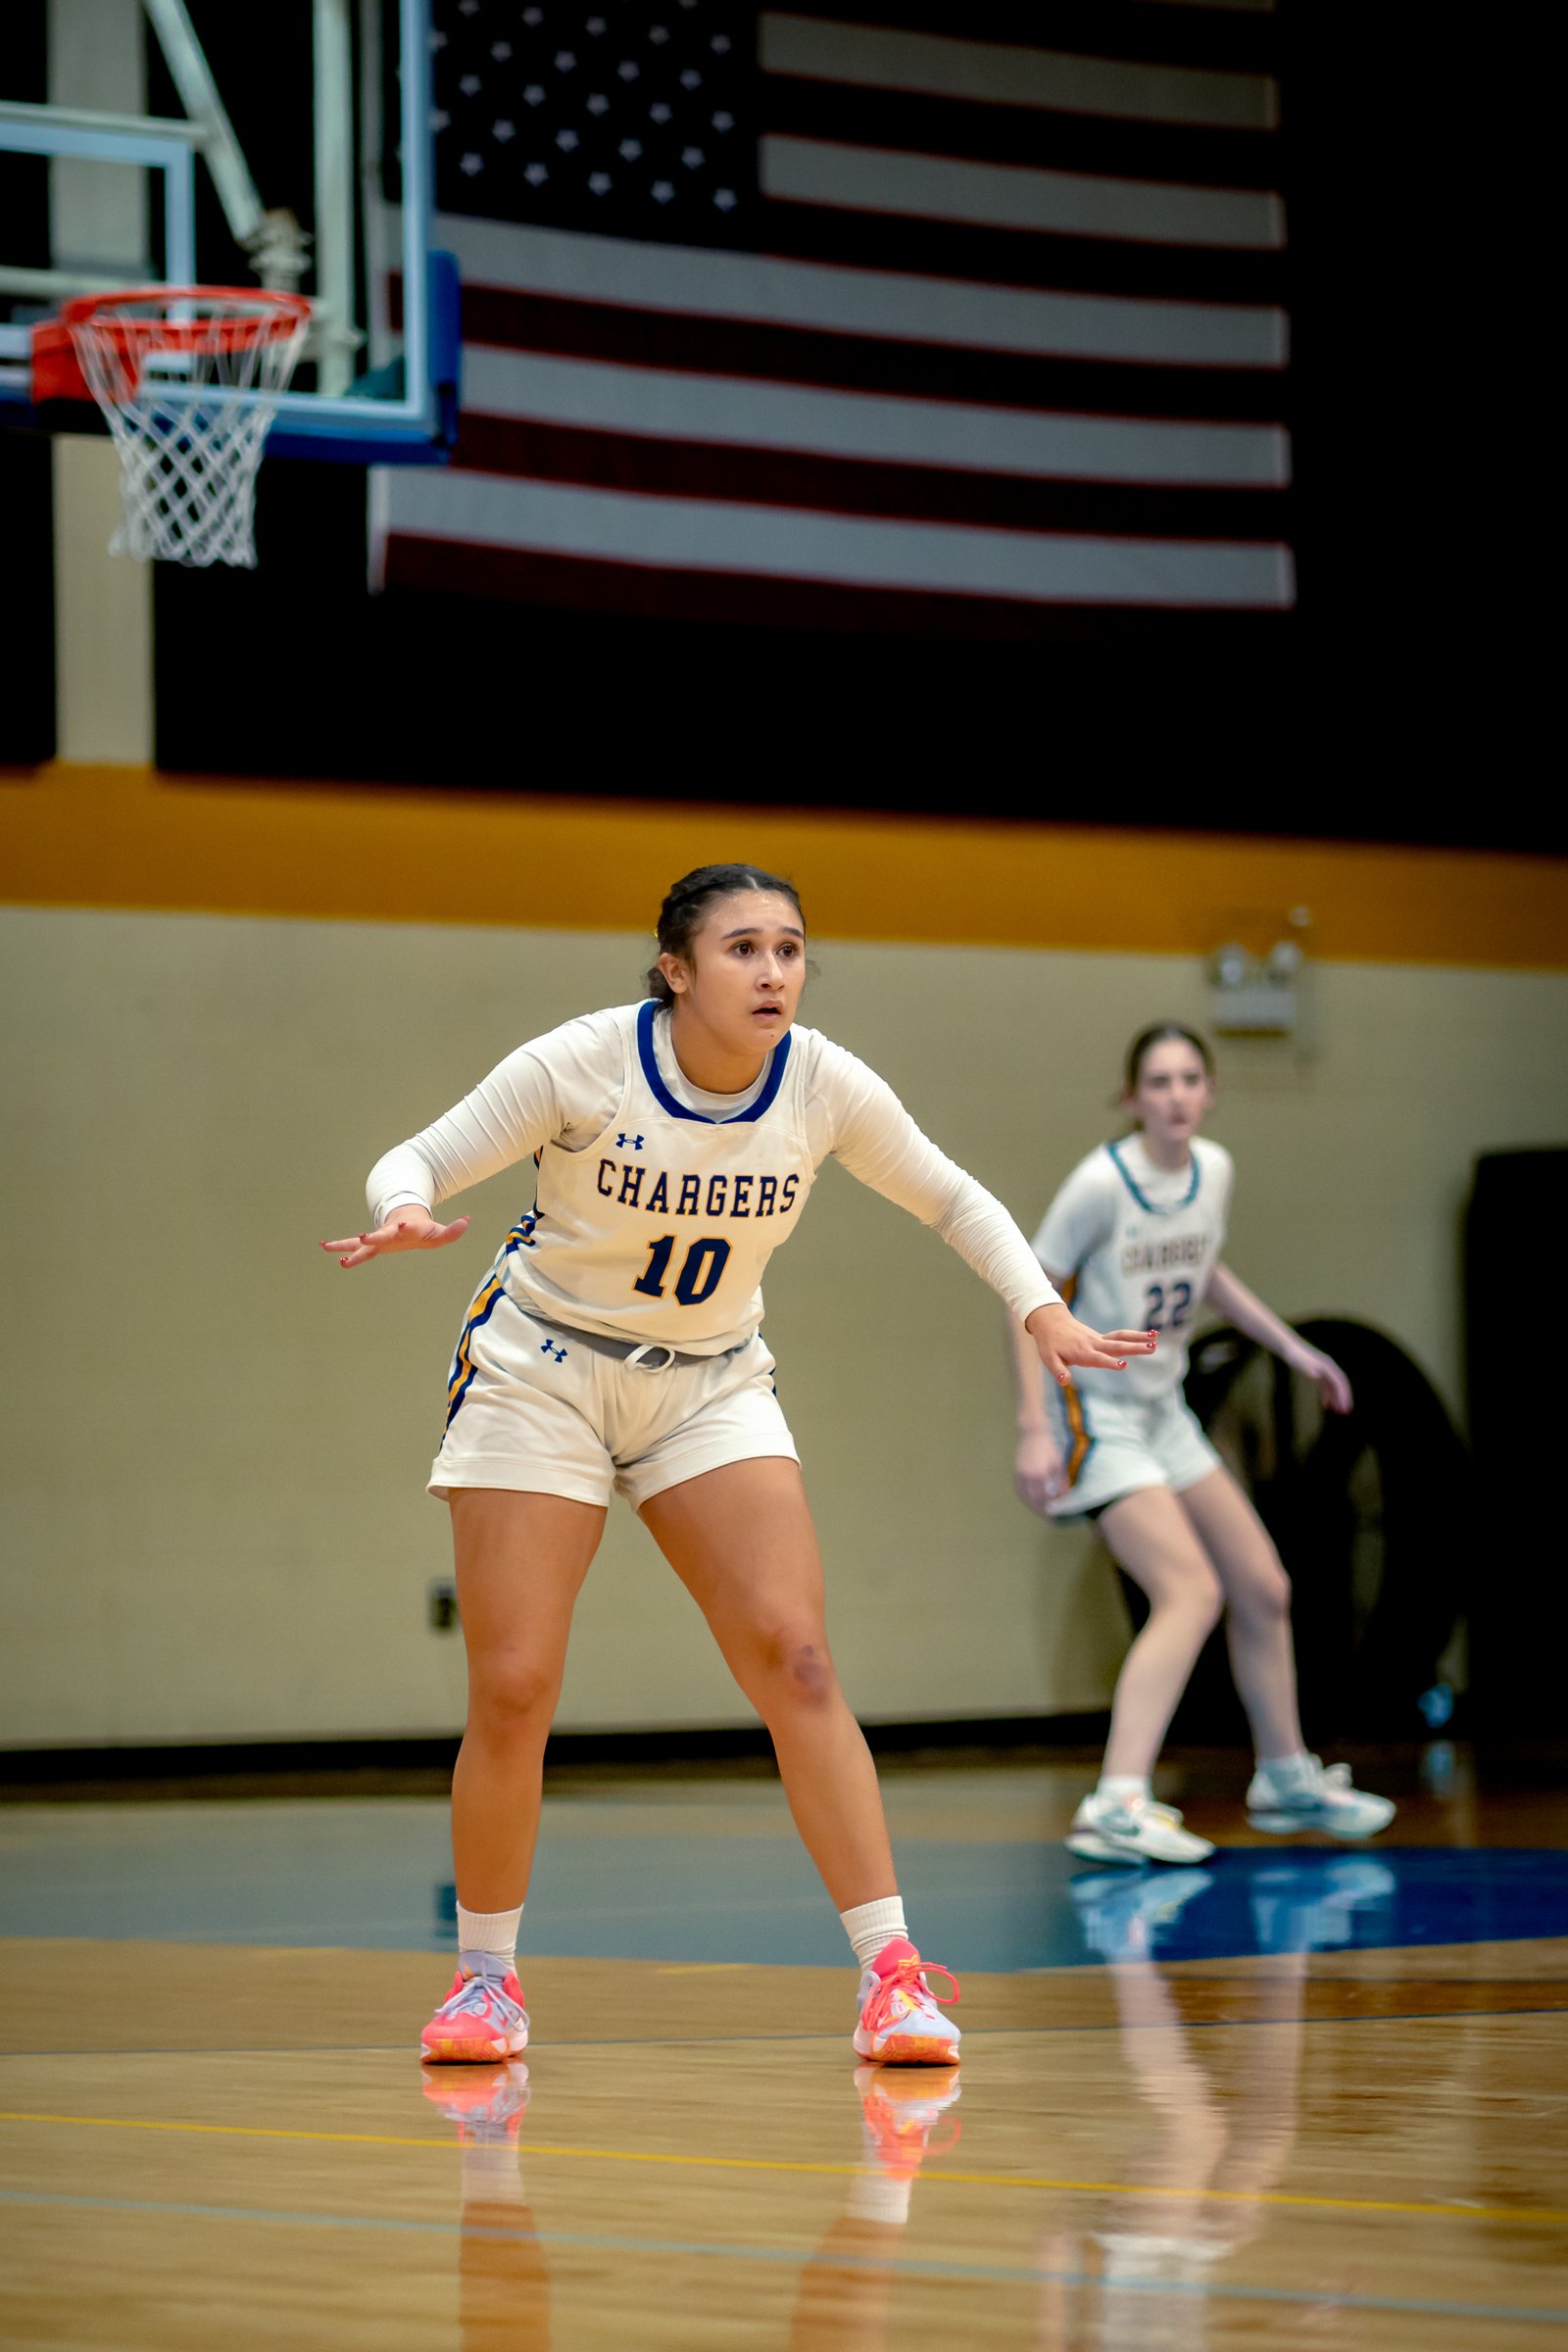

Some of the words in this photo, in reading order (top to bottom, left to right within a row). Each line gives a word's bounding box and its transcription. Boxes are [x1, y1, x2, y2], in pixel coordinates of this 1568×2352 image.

[597, 1158, 800, 1218] CHARGERS
[632, 1233, 733, 1307] 10
[1143, 1280, 1193, 1331] 22
